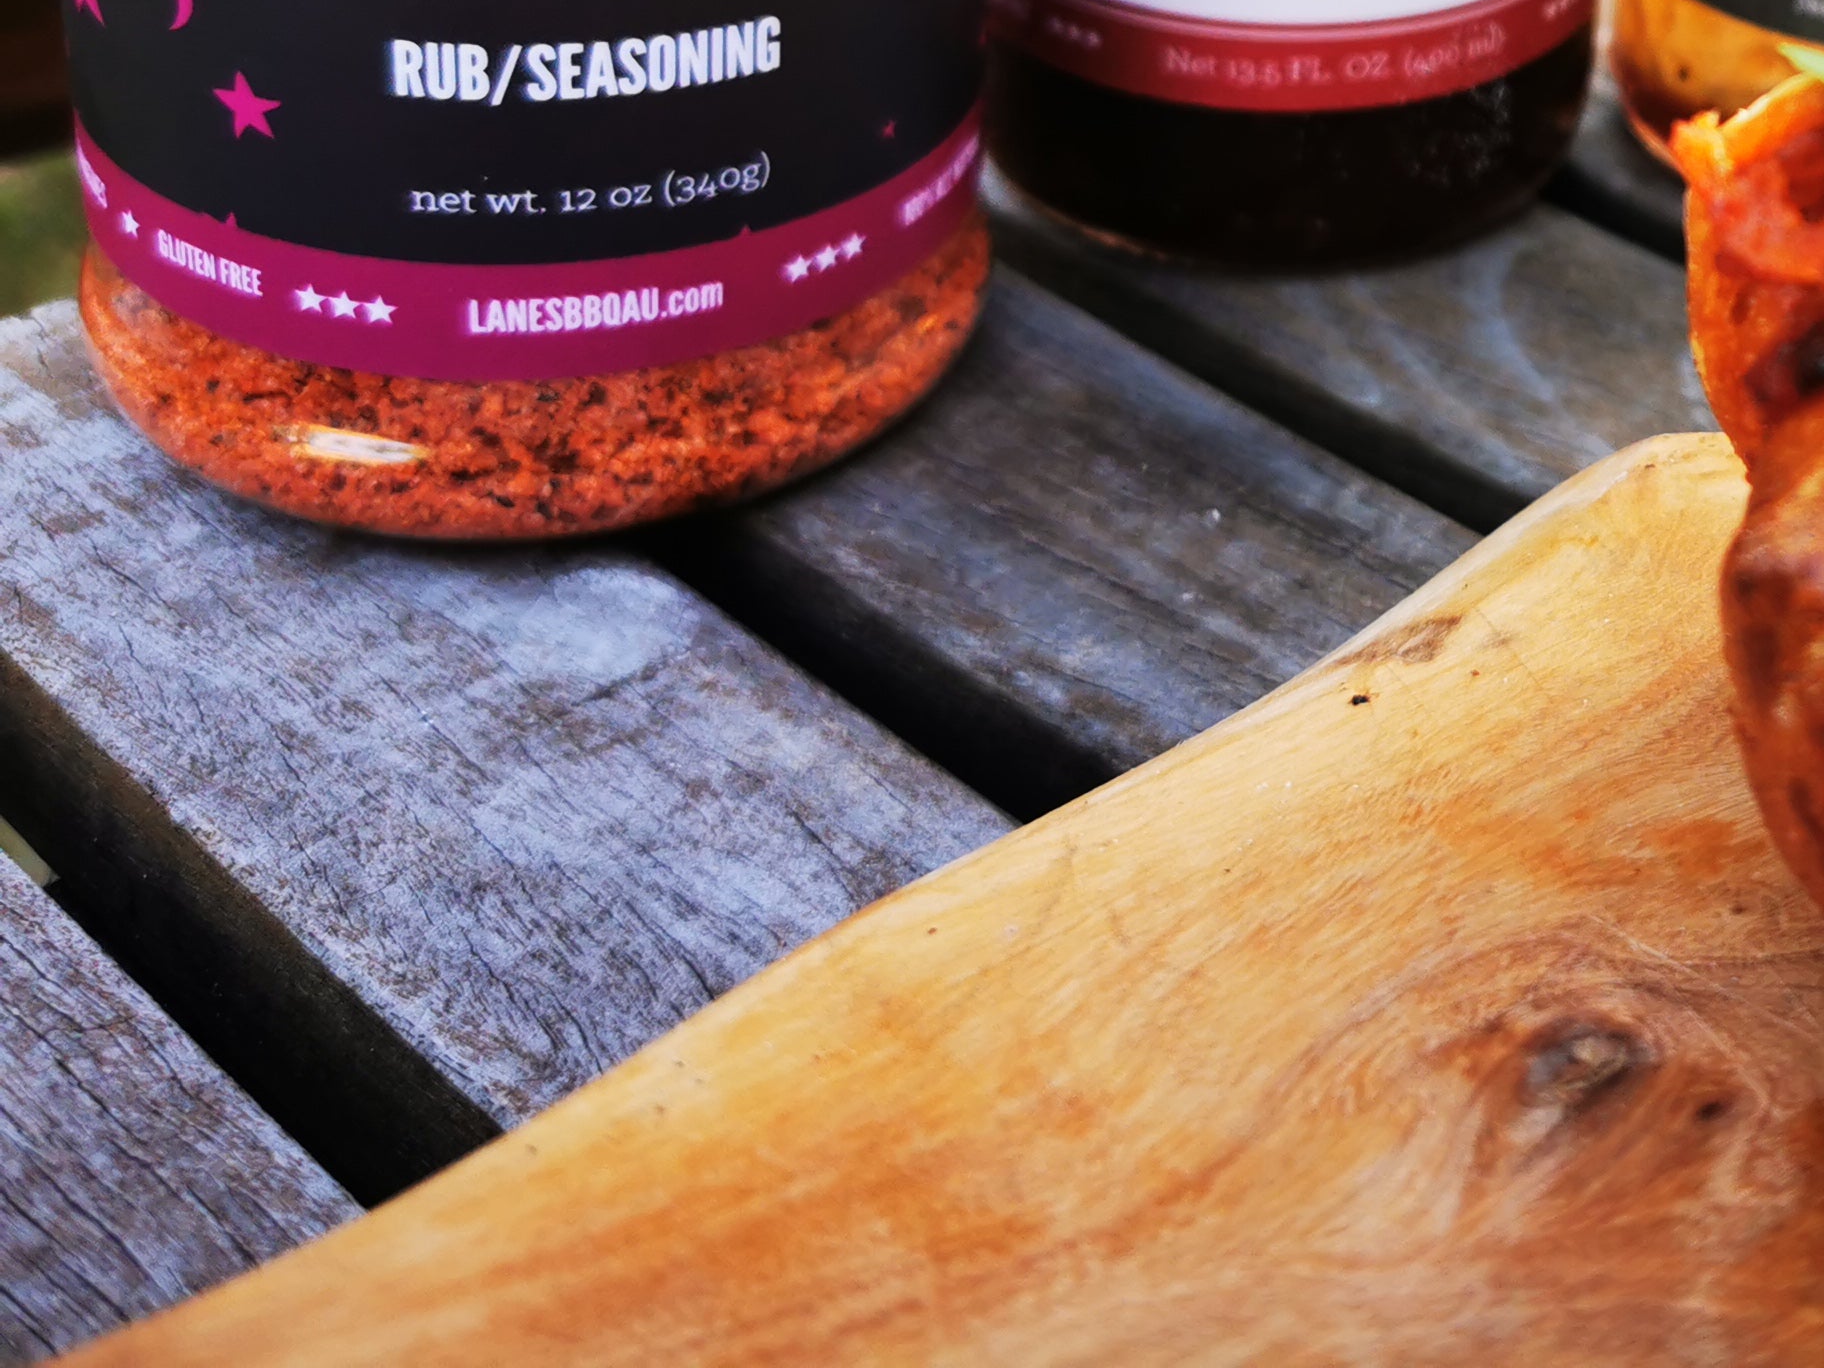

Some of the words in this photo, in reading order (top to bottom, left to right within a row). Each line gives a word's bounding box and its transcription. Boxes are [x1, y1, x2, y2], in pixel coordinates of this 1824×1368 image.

[390, 15, 782, 106] RUB/SEASONING
[409, 188, 478, 215] net
[486, 189, 548, 215] wt.
[560, 188, 599, 214] 12
[608, 183, 654, 207] oz
[663, 150, 772, 208] (340g)
[156, 227, 217, 283] GLUTEN
[219, 258, 265, 298] FREE
[466, 280, 725, 336] LANESBBQAU.com
